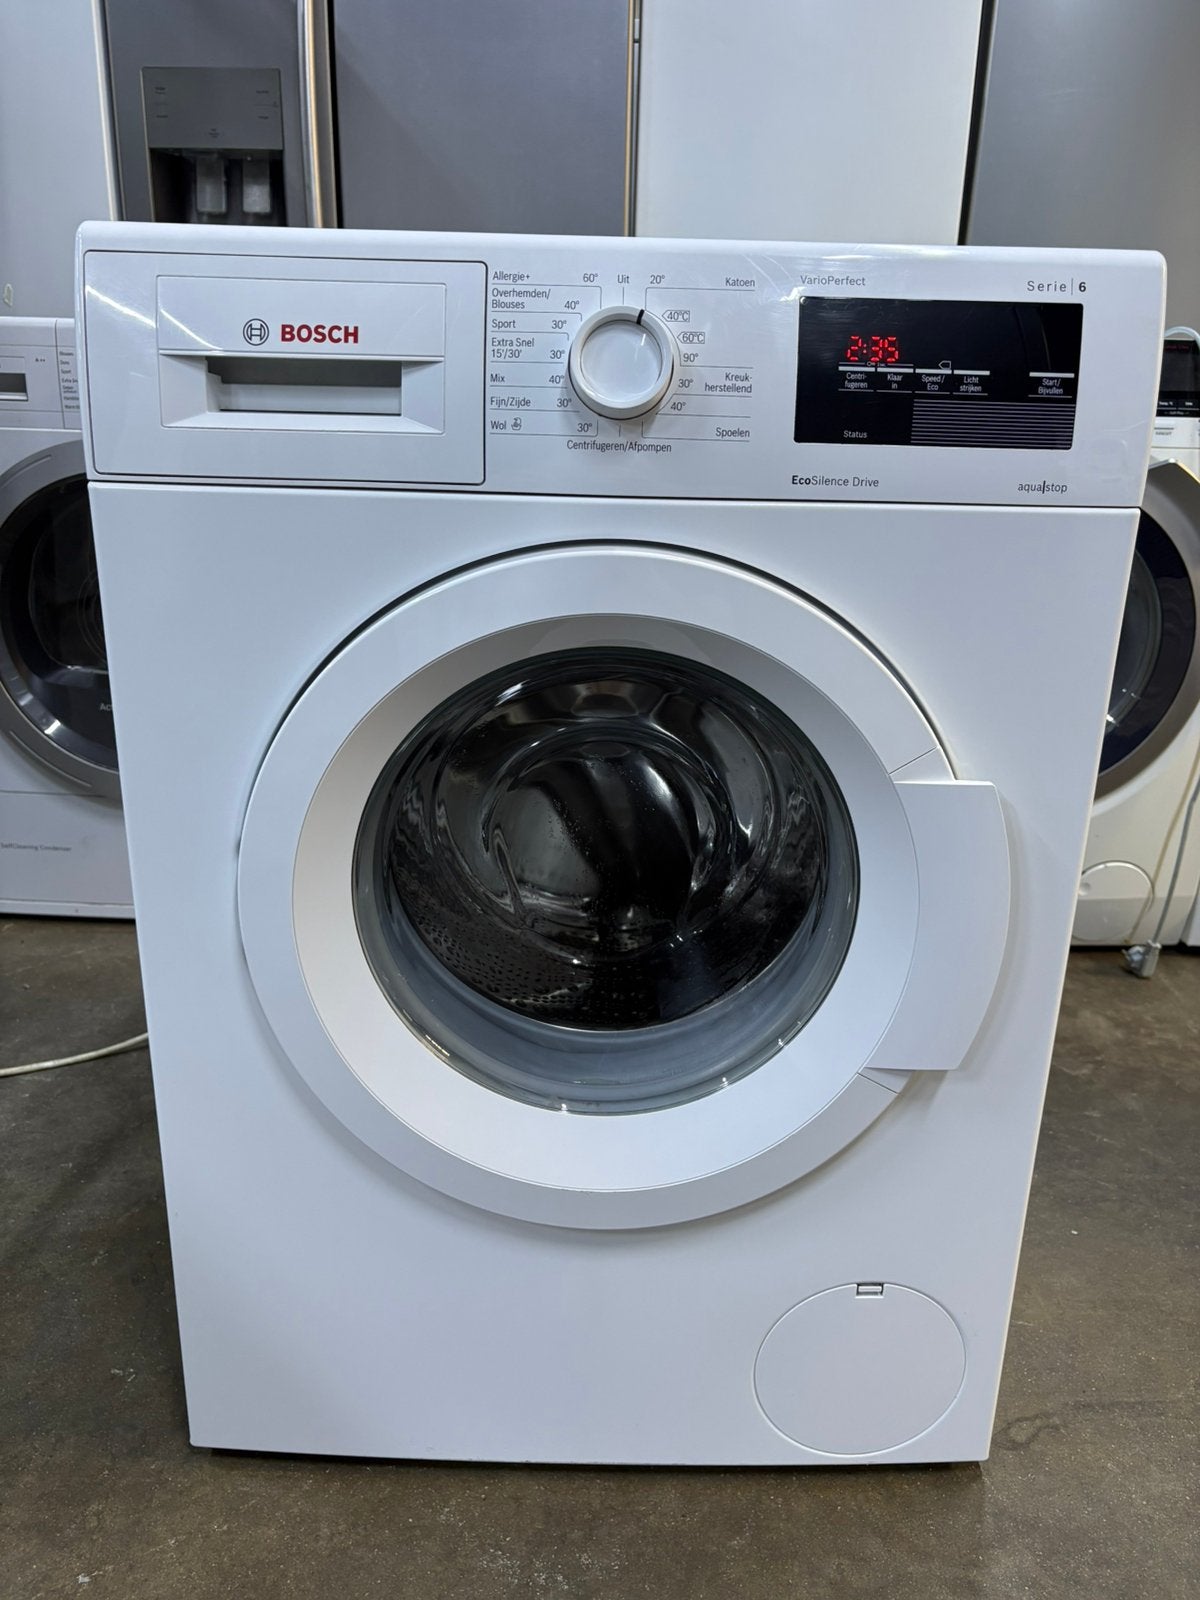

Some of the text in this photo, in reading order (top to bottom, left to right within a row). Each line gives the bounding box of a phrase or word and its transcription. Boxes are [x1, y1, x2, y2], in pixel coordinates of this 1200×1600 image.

[492, 271, 531, 283] Allergie+
[583, 273, 598, 283] 60°
[617, 274, 630, 284] Uit
[650, 274, 666, 284] 20°
[800, 275, 866, 286] VarioPerfect
[725, 277, 756, 288] Katoen
[1027, 280, 1087, 292] Serie 6
[491, 288, 551, 300] Overhemden/
[491, 300, 525, 310] Blouses
[564, 300, 580, 310] 40°
[667, 310, 689, 322] 40°C
[491, 319, 516, 331] Sport
[552, 320, 568, 330] 30°
[281, 324, 359, 344] BOSCH
[682, 332, 704, 344] 60°C
[491, 338, 534, 348] Extra Snel
[846, 335, 899, 362] 2:35
[550, 350, 566, 360] 30°
[683, 352, 698, 363] 90°
[490, 374, 505, 383] Mix
[548, 375, 565, 384] 40°
[725, 372, 752, 382] Kreuk-
[846, 372, 868, 380] Centri-
[887, 373, 904, 382] Klaar
[921, 374, 945, 384] Speed/
[963, 376, 979, 384] Licht
[678, 378, 694, 388] 30°
[844, 380, 868, 390] fugeren
[1042, 378, 1061, 387] Start/
[704, 382, 752, 394] herstellend
[960, 384, 982, 393] strijken
[1038, 386, 1064, 395] Bijvullen
[490, 396, 531, 408] Fijn/Zijde
[556, 398, 572, 408] 30°
[670, 401, 686, 412] 40°
[490, 420, 507, 430] Wol
[577, 422, 592, 432] 30°
[715, 427, 750, 439] Spoelen
[843, 430, 868, 438] Status
[566, 440, 672, 454] Centrifugeren/Afpompen
[792, 475, 880, 488] EcoSilence Drive
